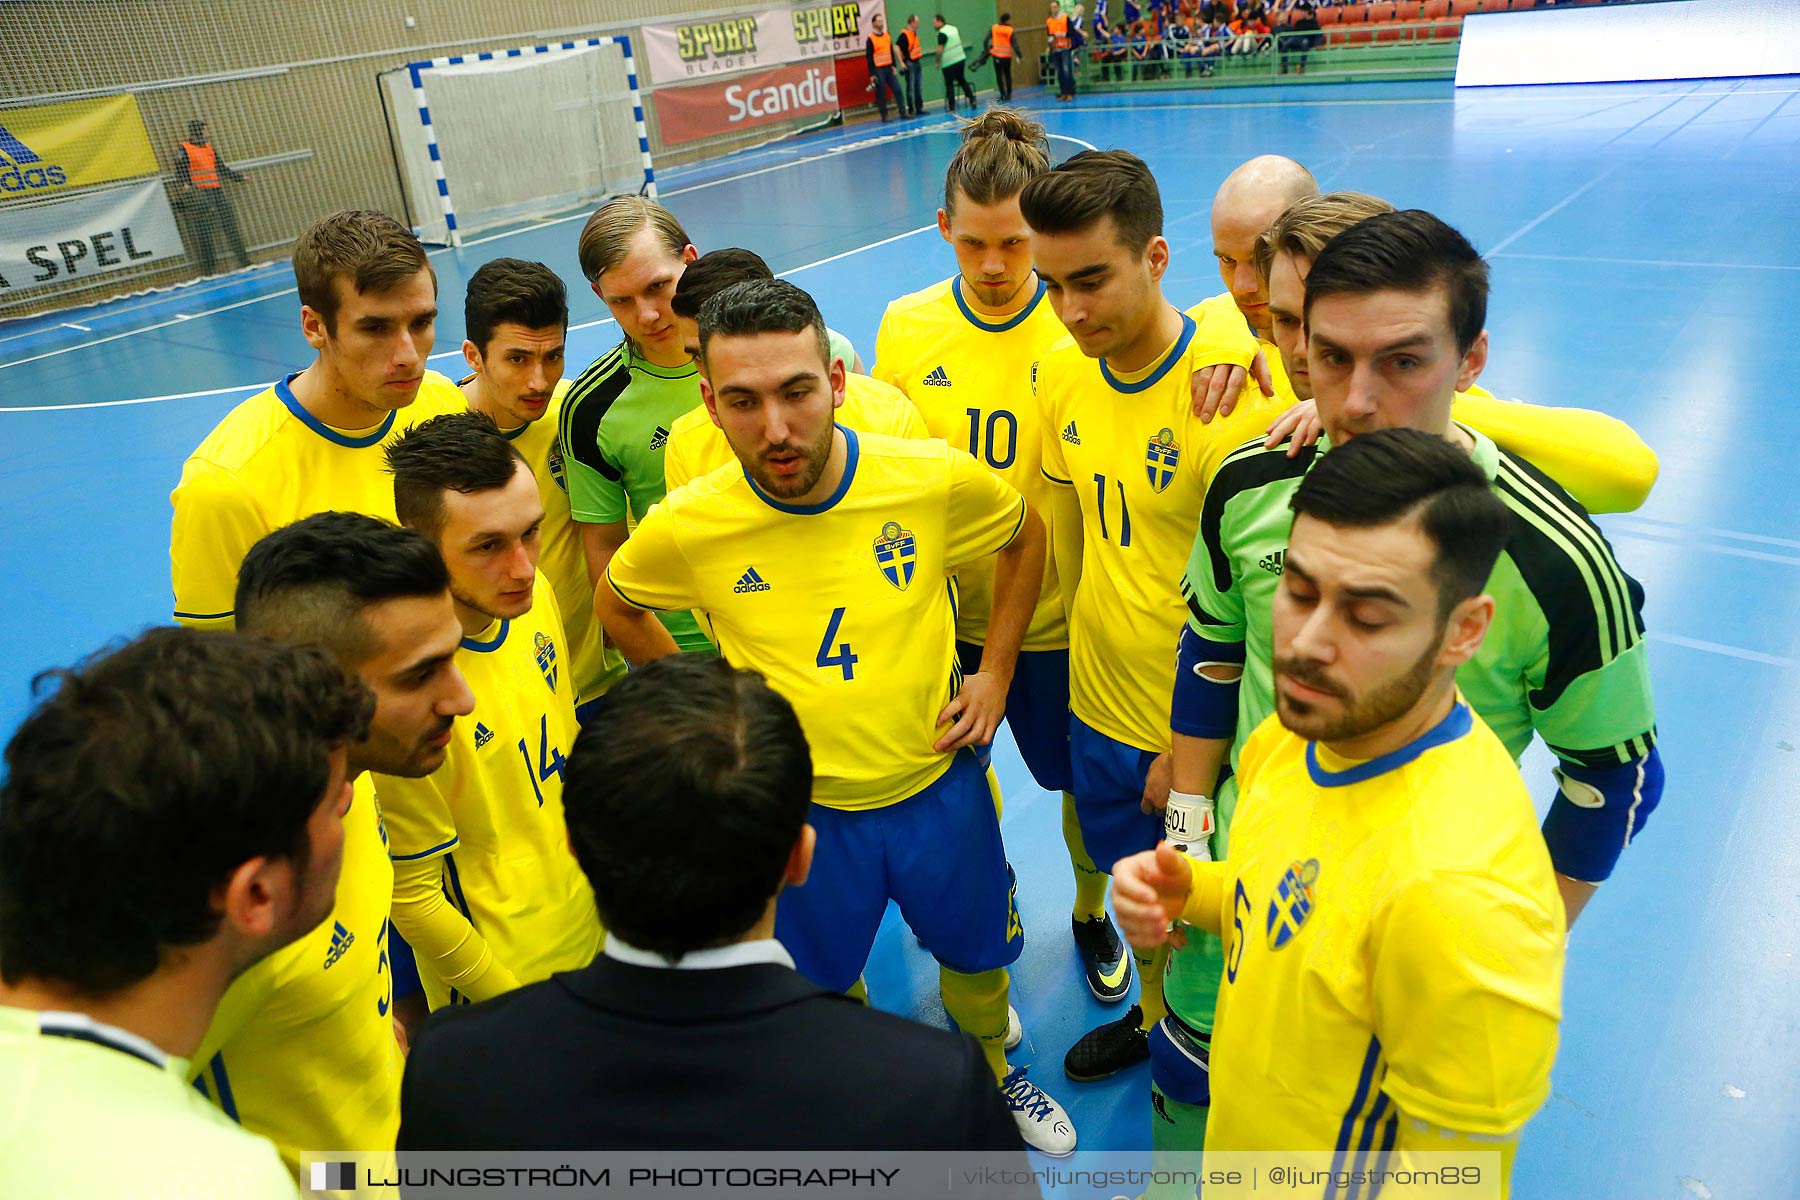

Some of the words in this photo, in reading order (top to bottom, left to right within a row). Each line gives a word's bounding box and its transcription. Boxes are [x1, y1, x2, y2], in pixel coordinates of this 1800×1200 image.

[676, 16, 758, 62] SPORT
[792, 3, 861, 43] SPORT
[686, 54, 758, 76] BLADET
[800, 38, 861, 56] BLADET
[725, 69, 837, 122] Scandic
[0, 165, 67, 193] das
[26, 227, 153, 282] SPEL
[923, 376, 952, 387] adidas
[966, 408, 1018, 469] 10
[1062, 433, 1081, 446] adidas
[1094, 473, 1131, 547] 11
[733, 582, 771, 594] adidas
[816, 607, 858, 681] 4
[518, 713, 567, 808] 14
[323, 932, 355, 970] adidas
